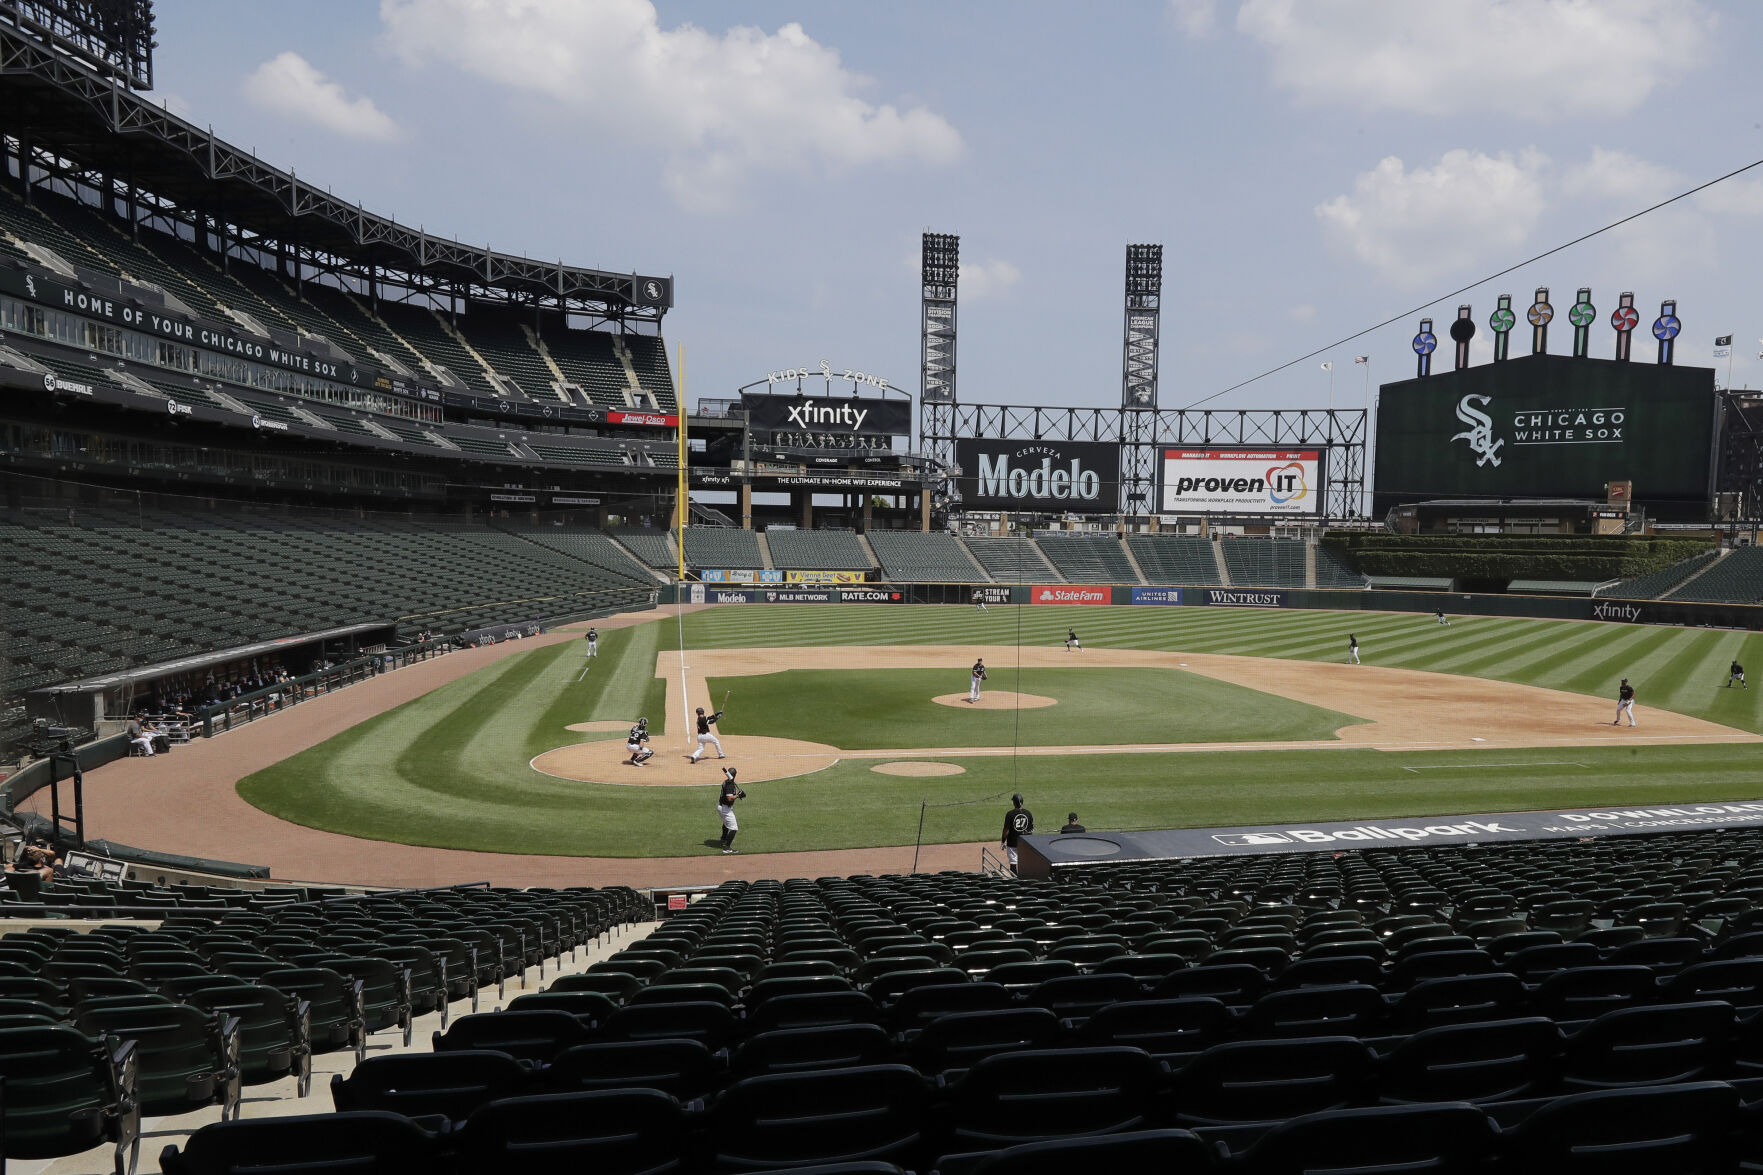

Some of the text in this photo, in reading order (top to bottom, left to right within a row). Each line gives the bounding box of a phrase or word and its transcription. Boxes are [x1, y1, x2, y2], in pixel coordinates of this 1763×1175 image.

[64, 290, 336, 377] HOME OF YOUR CHICAGO WHITE SOX
[768, 367, 808, 384] KIDS
[842, 369, 888, 390] ZONE
[56, 380, 93, 395] BUEHRLE
[177, 404, 192, 414] FISK
[788, 400, 868, 430] xfinity
[1514, 412, 1624, 427] CHICAGO
[1515, 428, 1622, 440] WHITE SOX
[1016, 446, 1060, 460] CERVEZA
[976, 454, 1100, 500] Modelo
[1176, 475, 1296, 495] proven IT
[718, 592, 746, 603] Modelo
[1594, 602, 1641, 622] xfinity
[1015, 818, 1026, 828] 27
[1542, 823, 1608, 833] MAPS
[1286, 821, 1520, 842] Ballpark
